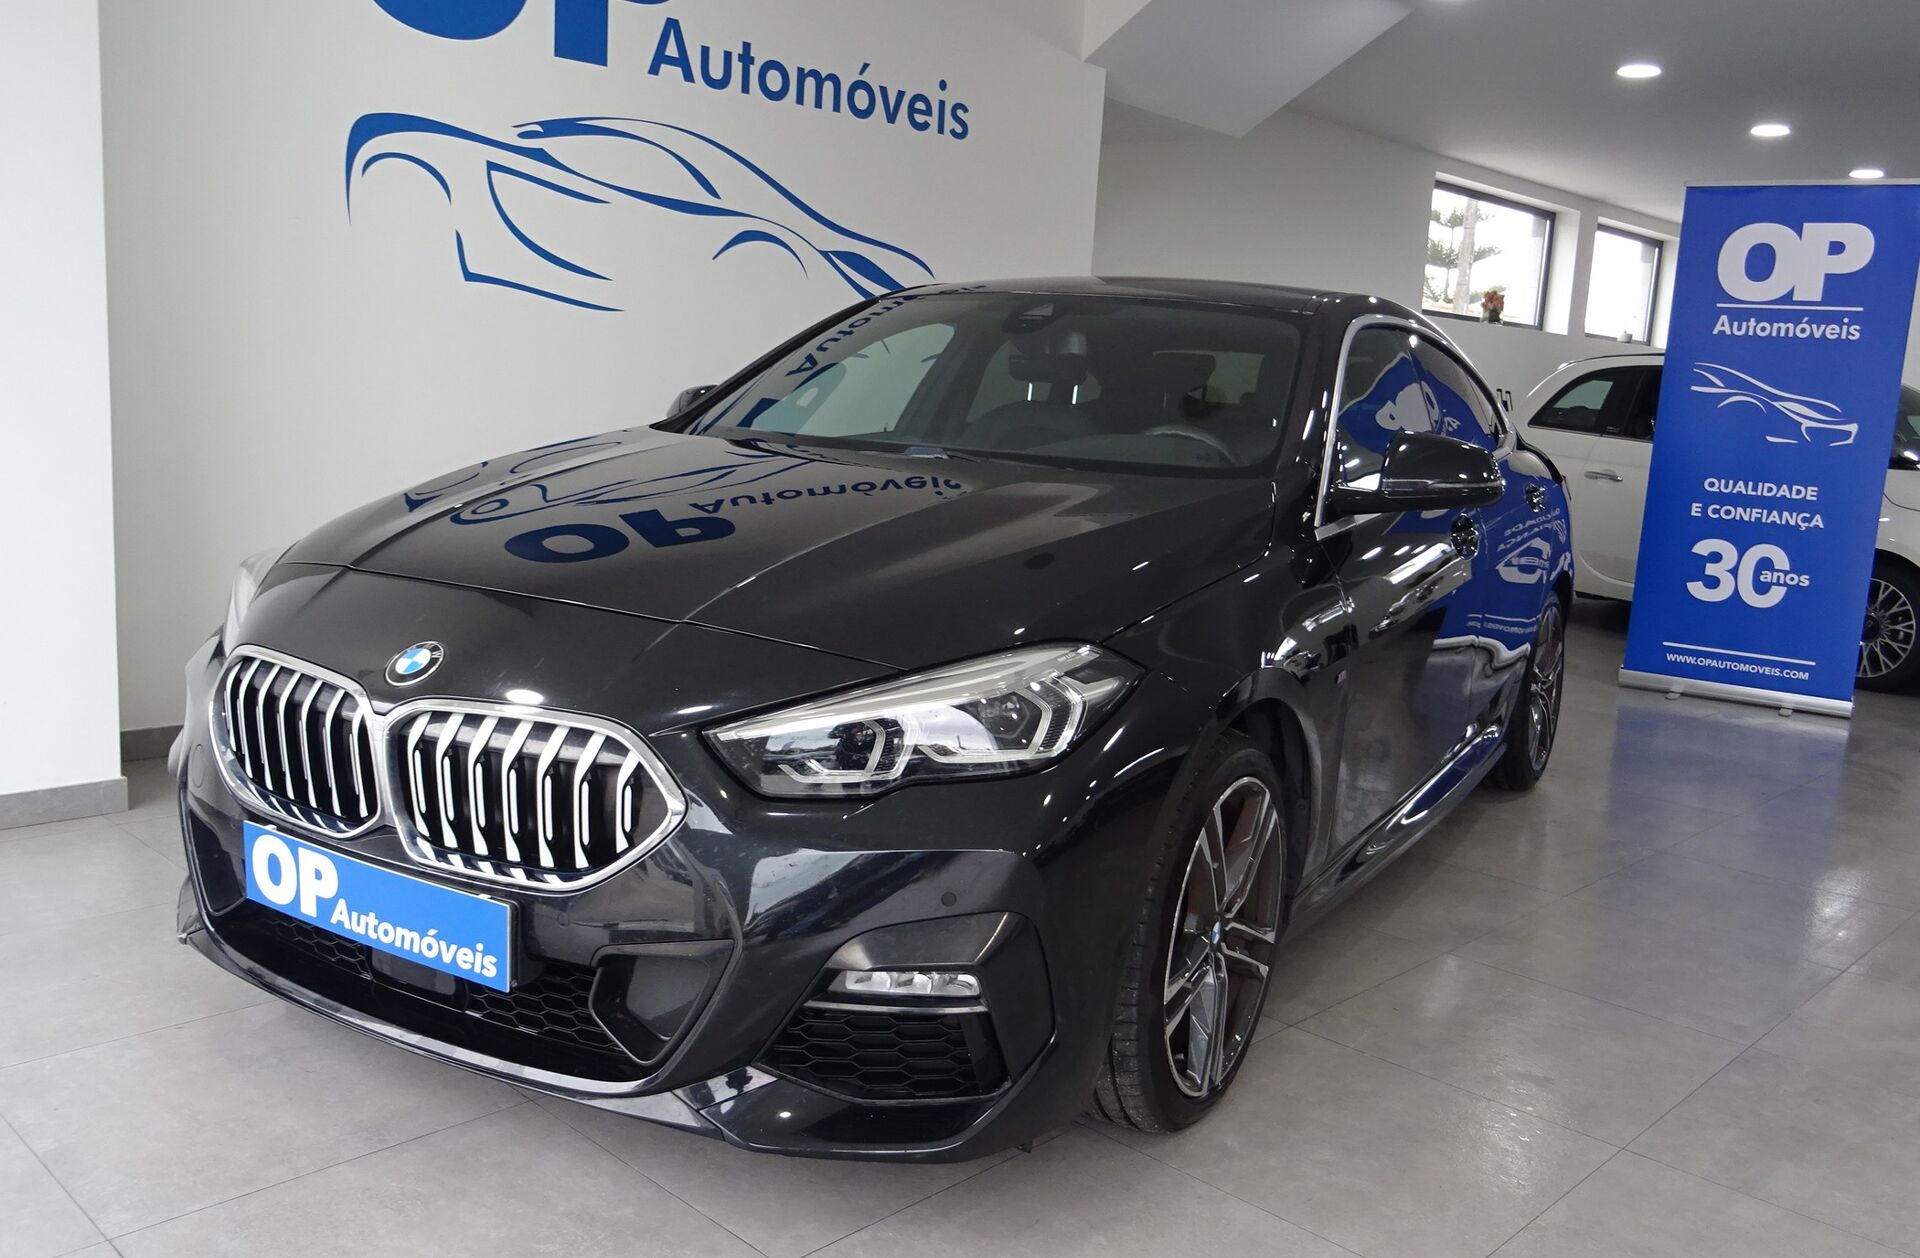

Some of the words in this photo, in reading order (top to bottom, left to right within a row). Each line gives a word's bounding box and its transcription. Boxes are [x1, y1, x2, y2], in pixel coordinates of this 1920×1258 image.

[647, 17, 970, 140] Automóveis
[1717, 222, 1875, 302] OP
[1712, 315, 1862, 341] Automóveis
[1703, 478, 1819, 501] QUALIDADE
[1690, 503, 1703, 517] E
[1707, 504, 1825, 531] CONFIANÇA
[1686, 538, 1791, 609] 30
[1759, 570, 1811, 587] anos
[1666, 653, 1810, 681] WWW.OPAUTOMOVEIS.COM
[252, 834, 339, 919] OP
[330, 898, 498, 978] Automóveis
